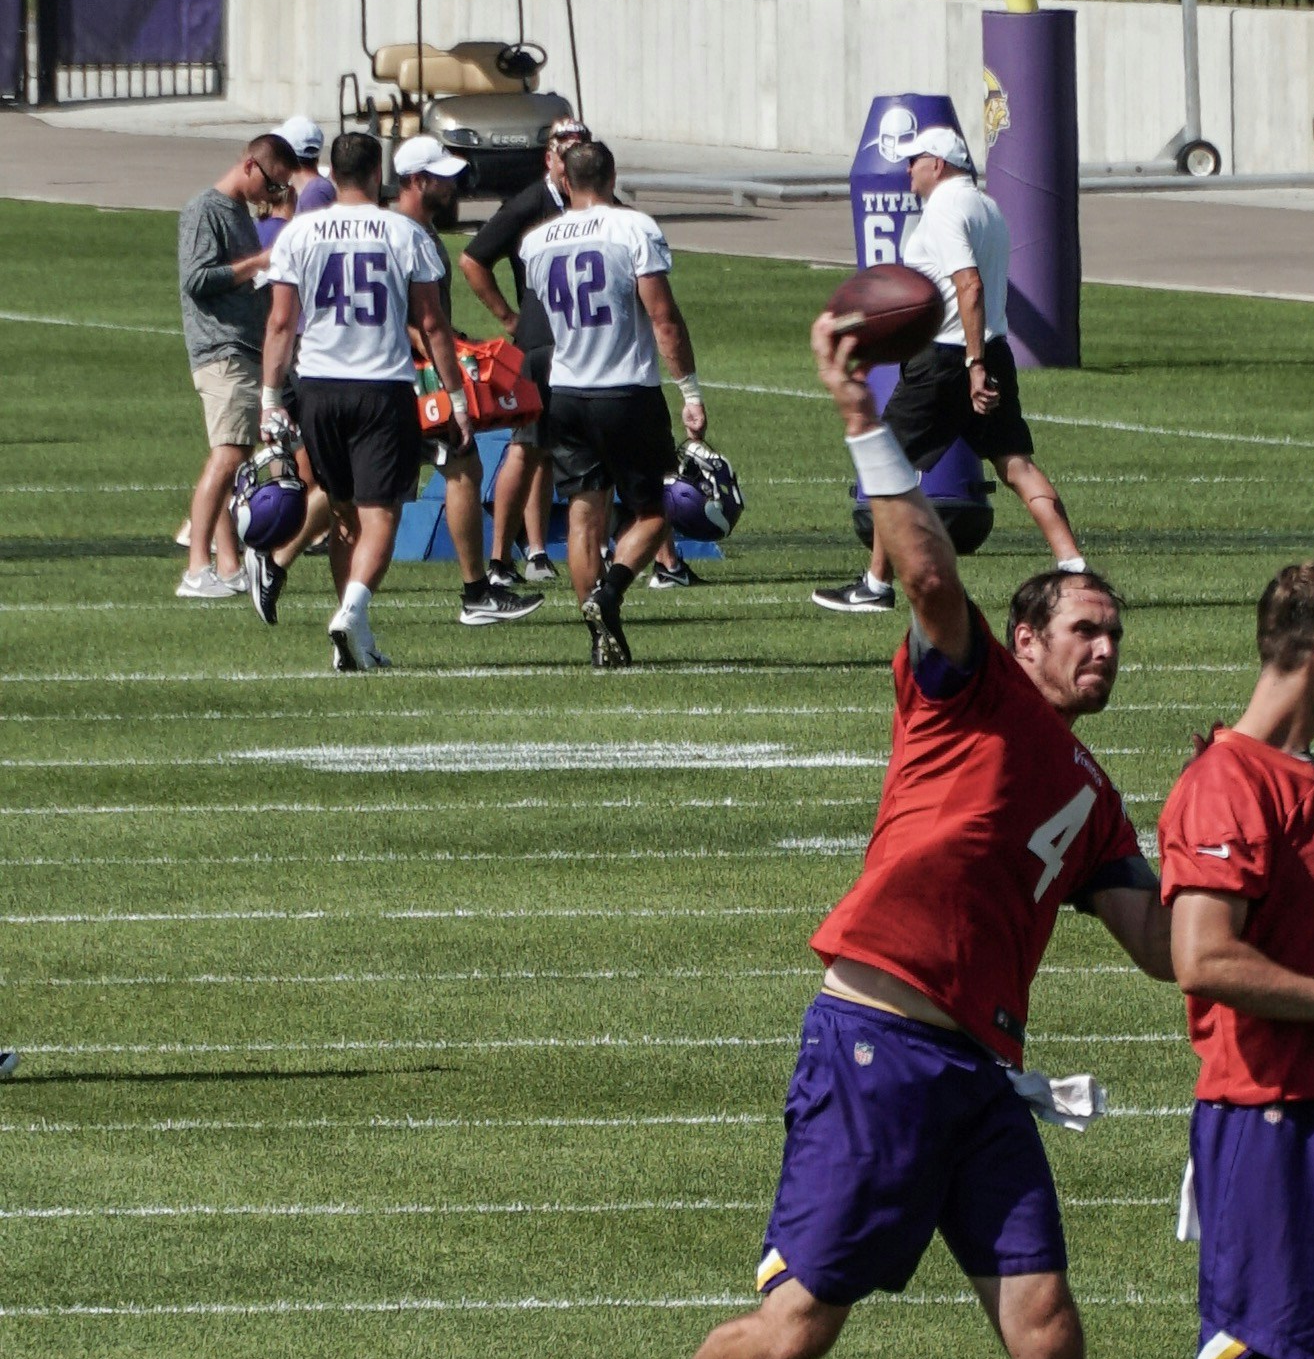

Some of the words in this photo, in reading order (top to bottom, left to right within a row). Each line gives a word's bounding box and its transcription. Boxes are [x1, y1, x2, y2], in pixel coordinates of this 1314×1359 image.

[314, 219, 386, 241] MARTINI
[315, 252, 388, 327] 45
[548, 250, 613, 330] 42
[425, 398, 440, 422] G
[1026, 784, 1098, 904] 4
